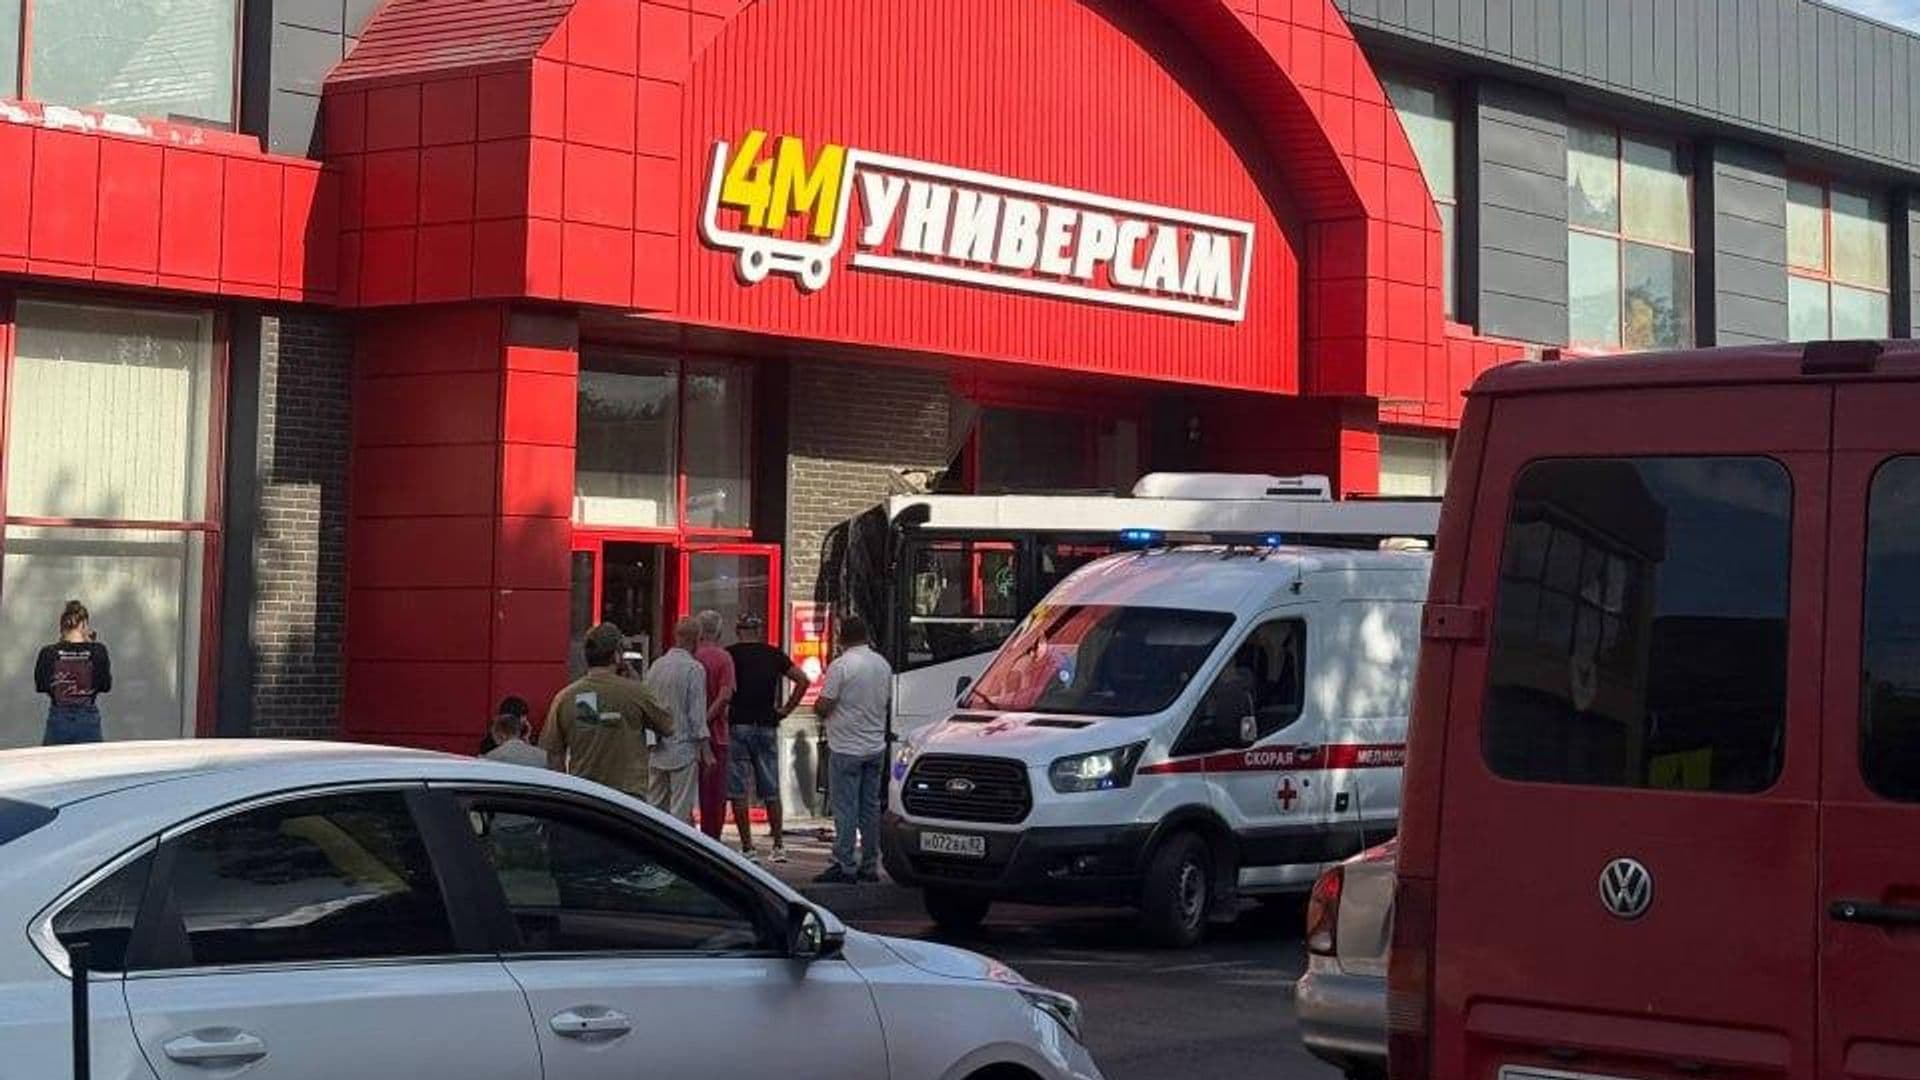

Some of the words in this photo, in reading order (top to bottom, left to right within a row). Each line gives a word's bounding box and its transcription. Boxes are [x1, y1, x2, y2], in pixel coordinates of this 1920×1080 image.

[722, 130, 848, 240] 4М
[858, 170, 1236, 302] УНИВЕРСАМ
[1244, 751, 1294, 766] СКОРАЯ
